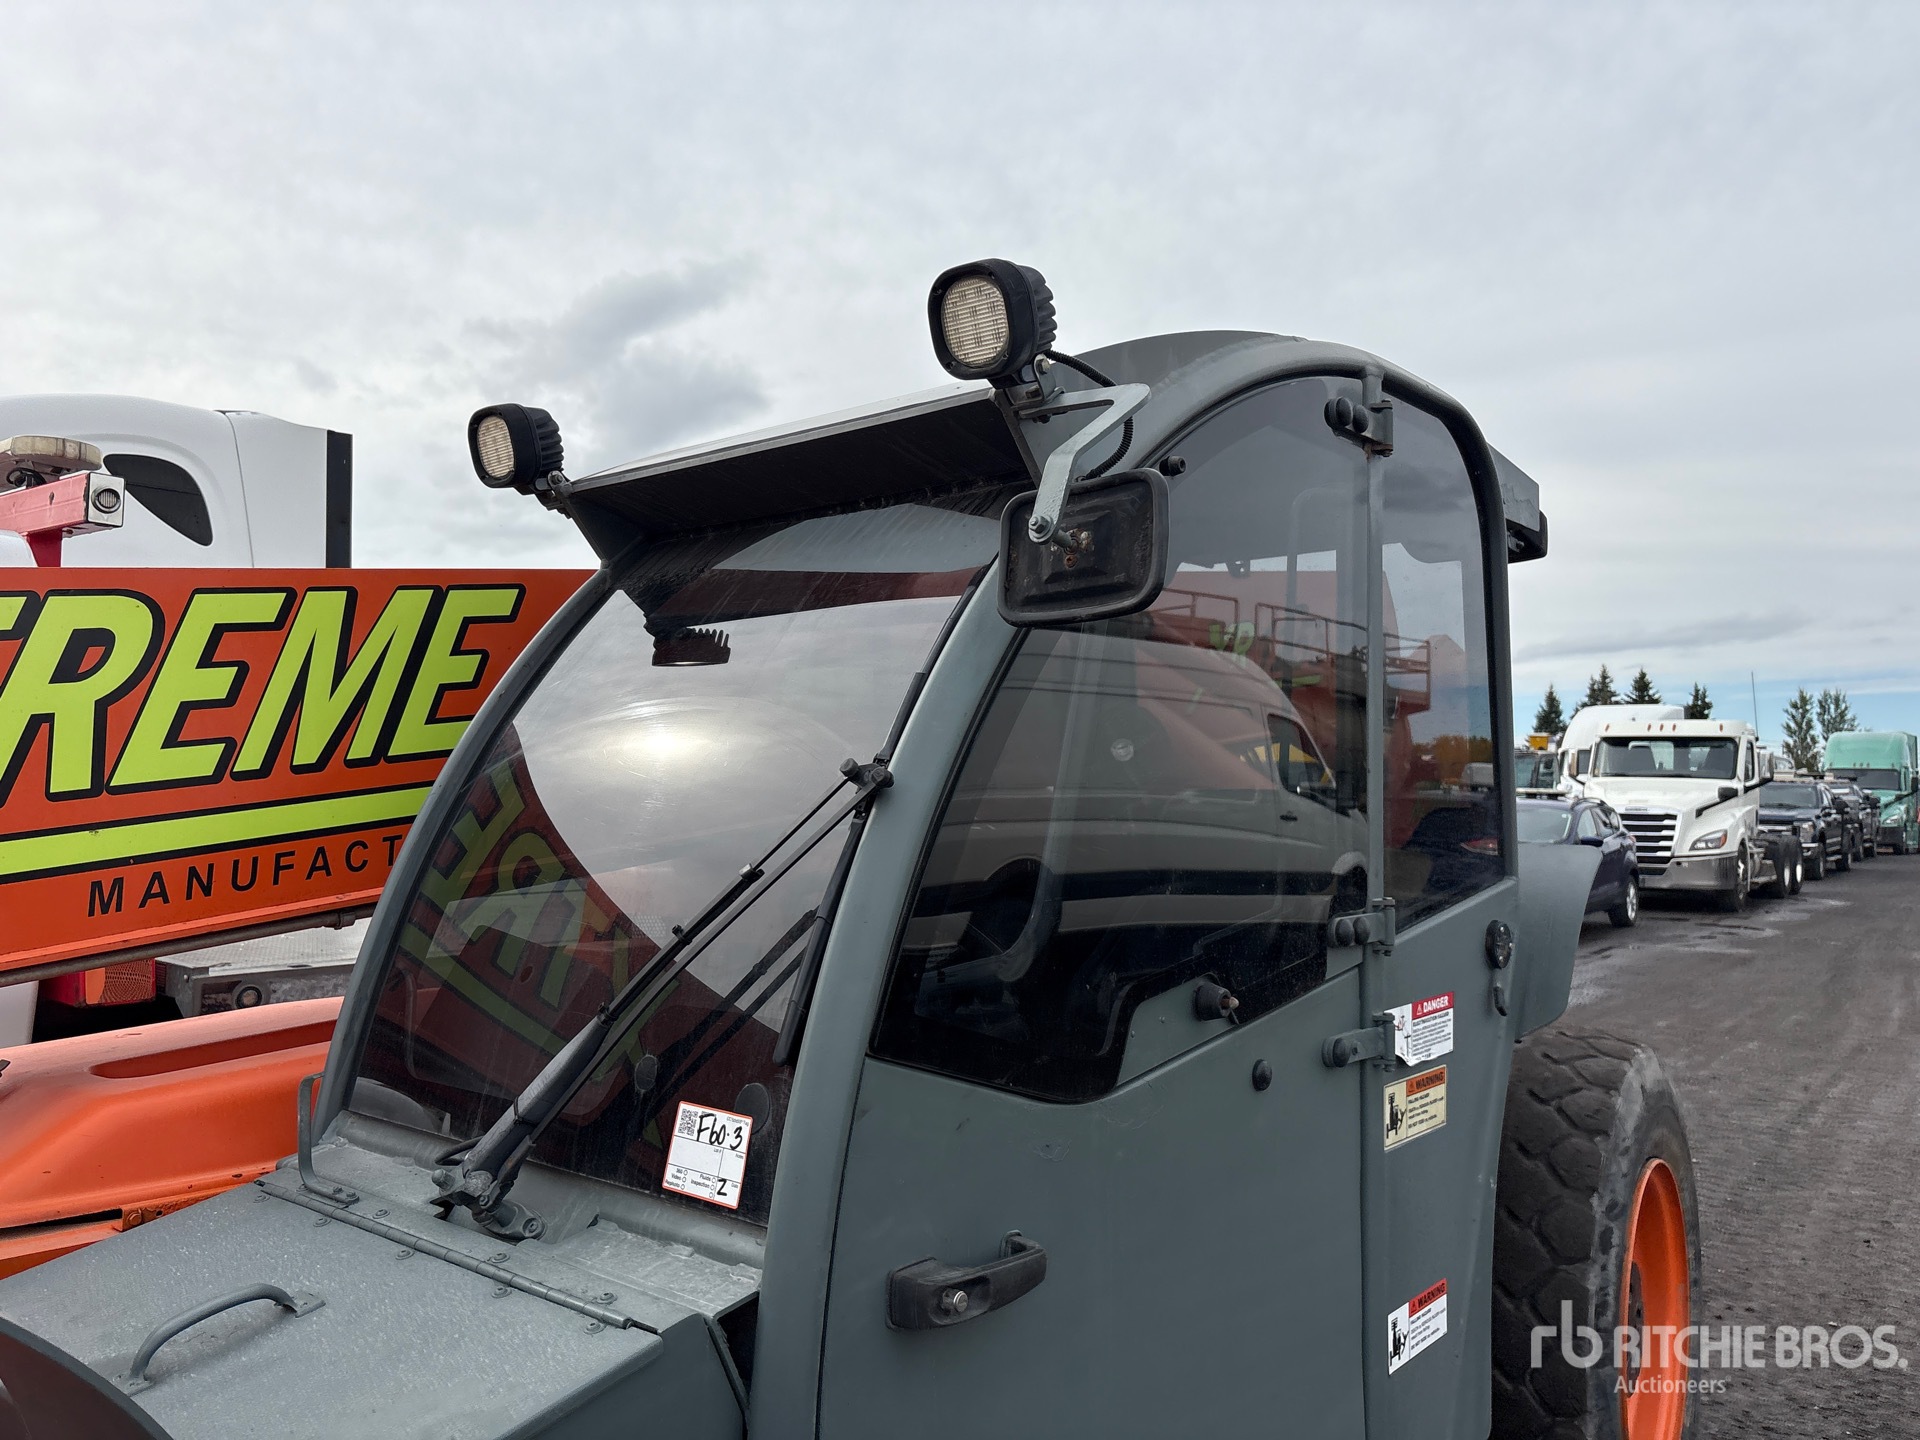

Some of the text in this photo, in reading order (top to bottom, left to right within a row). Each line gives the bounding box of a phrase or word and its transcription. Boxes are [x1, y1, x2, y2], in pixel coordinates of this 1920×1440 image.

[0, 585, 525, 808] REME
[1423, 995, 1449, 1013] DANGER
[1415, 1071, 1444, 1090] WARNING
[1417, 1282, 1446, 1309] WARNING
